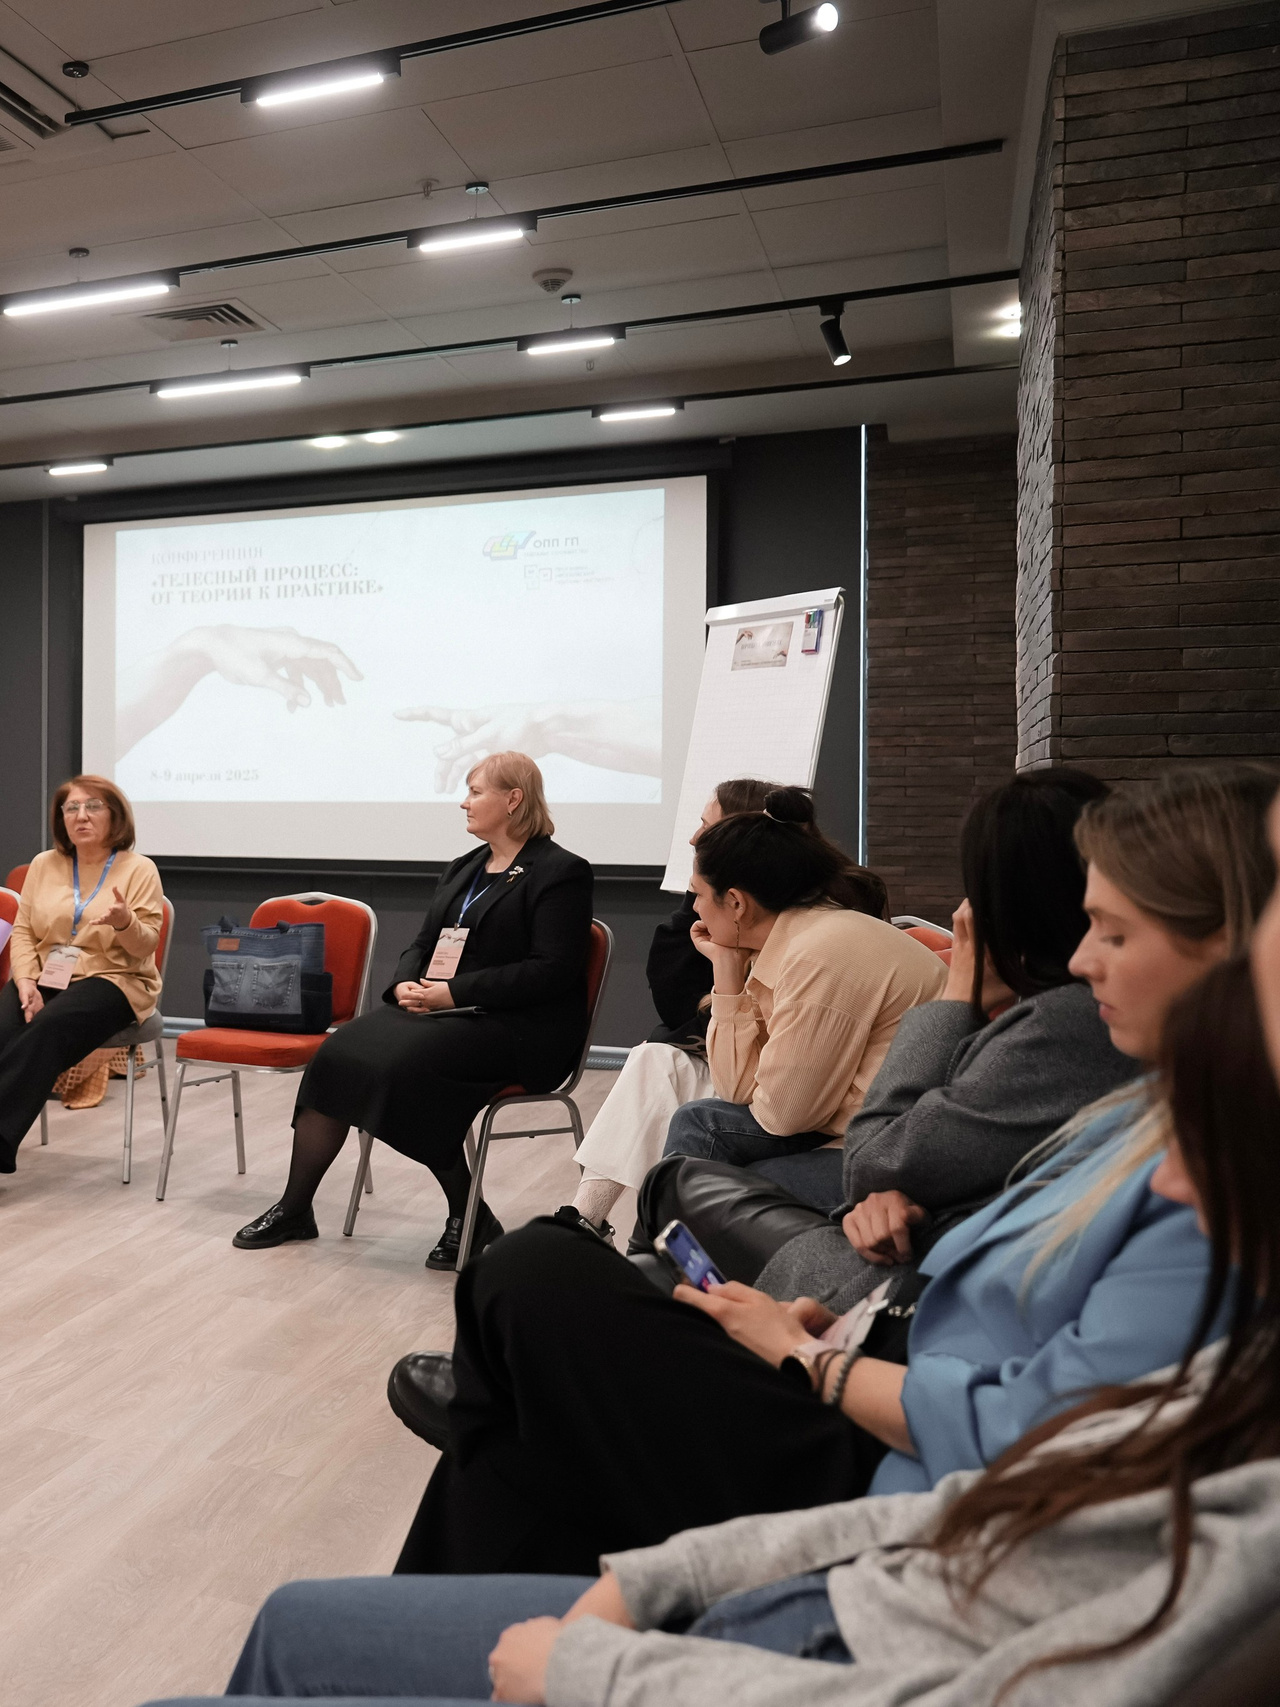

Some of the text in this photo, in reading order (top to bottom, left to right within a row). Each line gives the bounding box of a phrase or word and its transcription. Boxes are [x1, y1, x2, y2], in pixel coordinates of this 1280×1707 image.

[264, 563, 359, 583] ПРОЦЕСС:
[151, 578, 384, 605] ОТ ТЕОРИИ К ПРАКТИКЕ»
[225, 769, 260, 781] 2025
